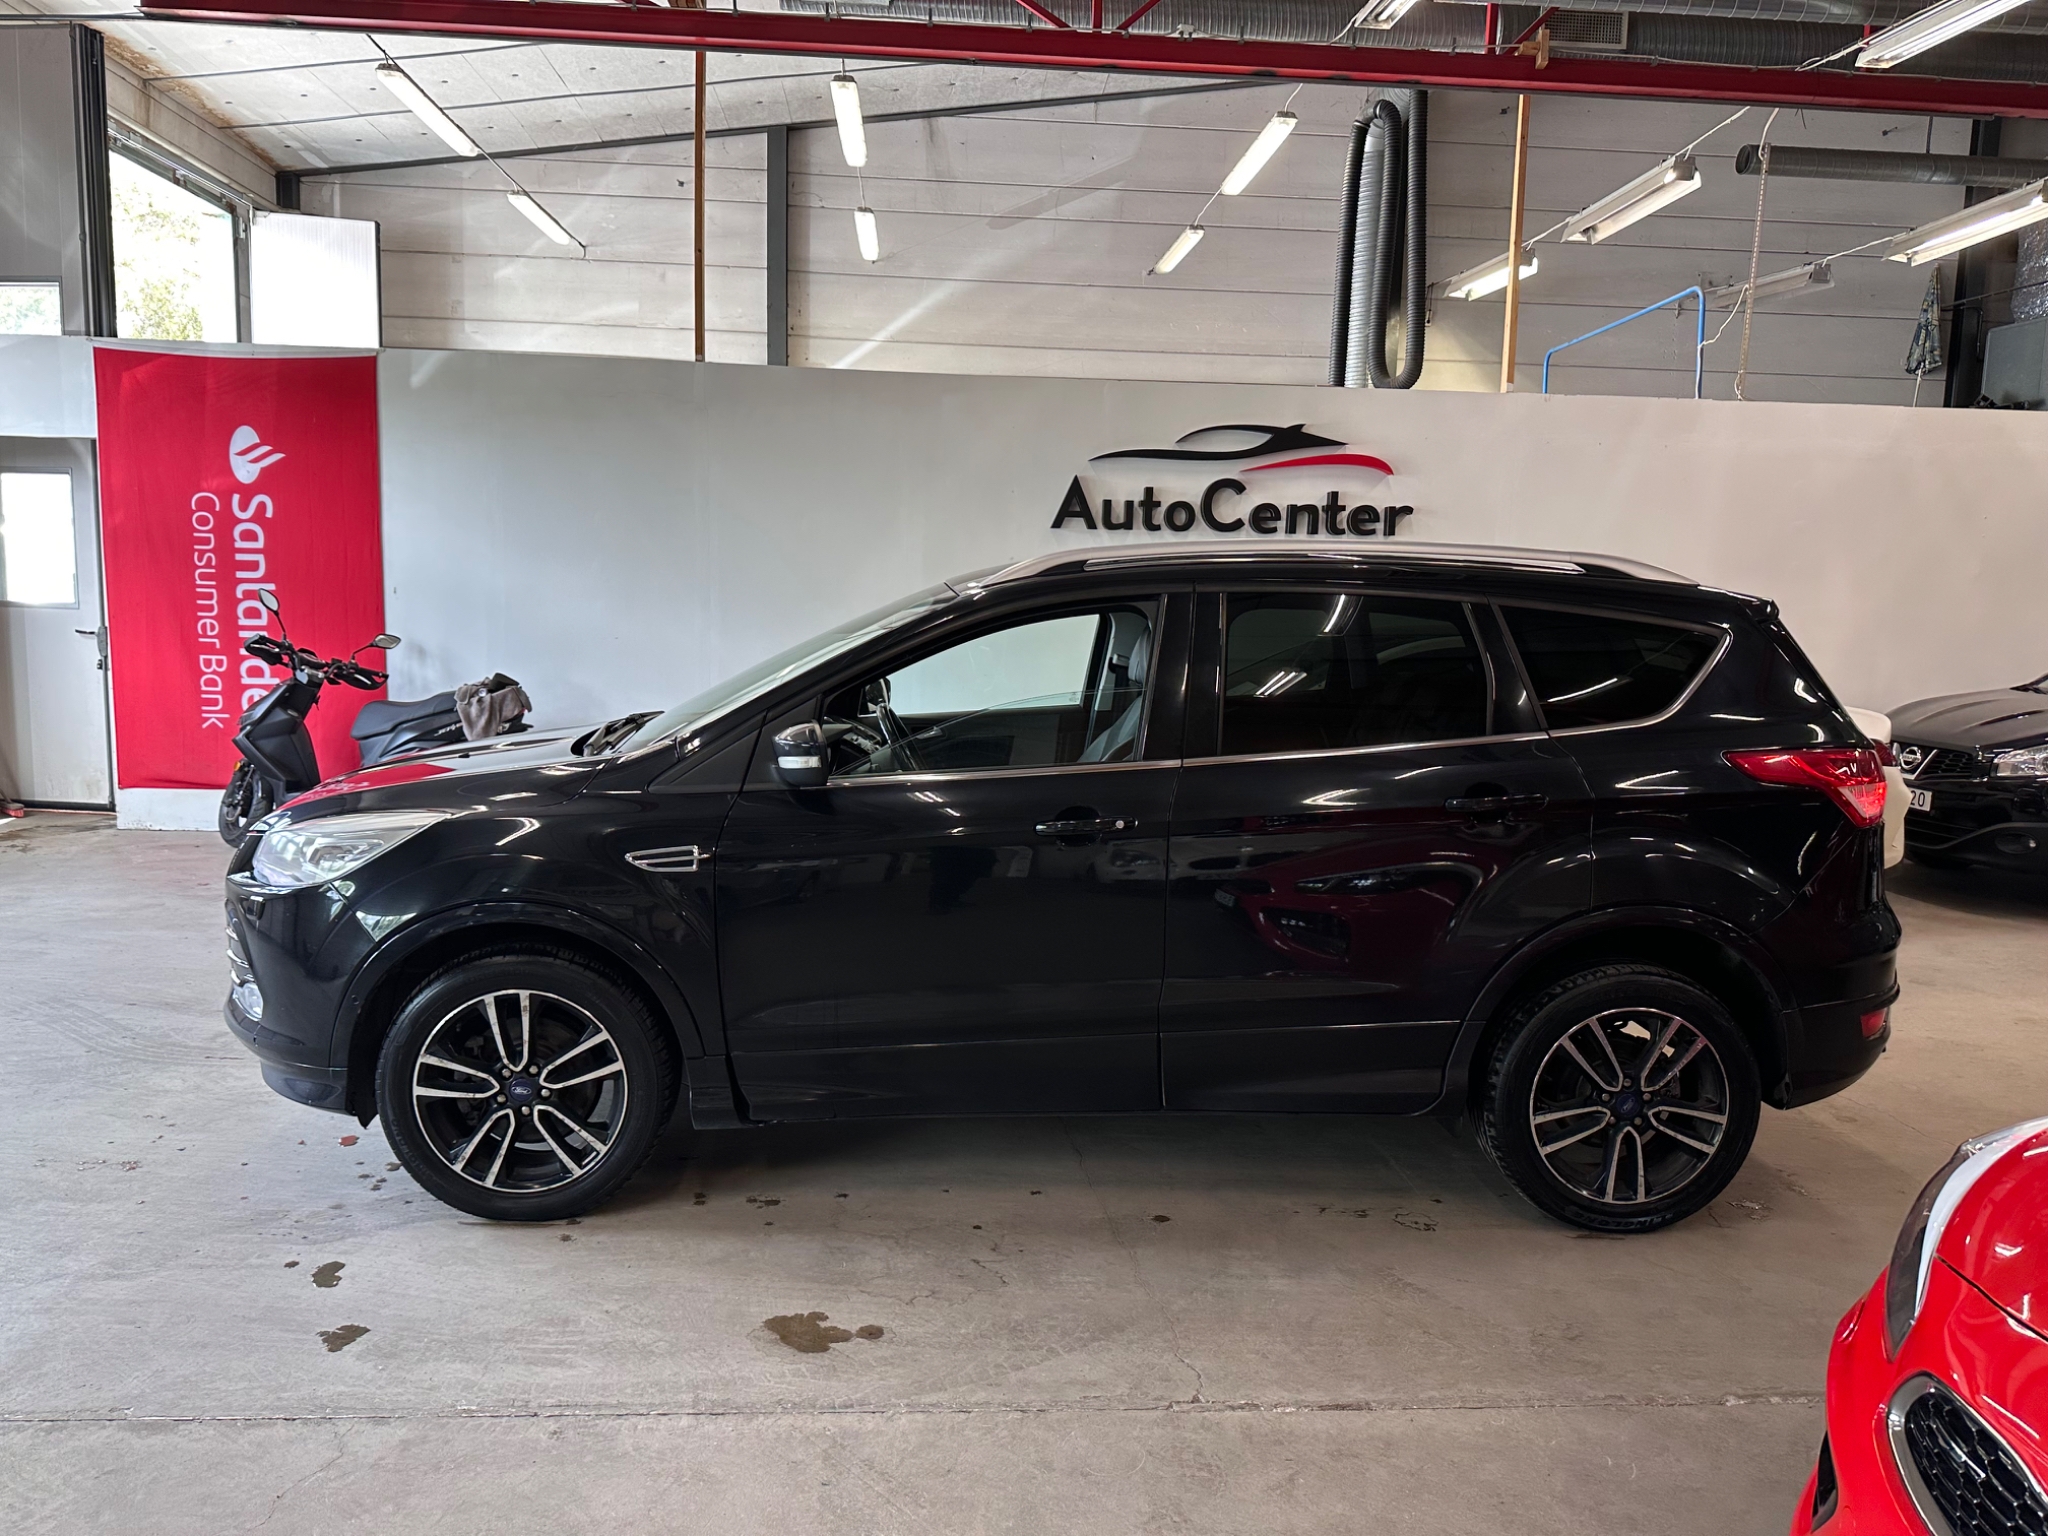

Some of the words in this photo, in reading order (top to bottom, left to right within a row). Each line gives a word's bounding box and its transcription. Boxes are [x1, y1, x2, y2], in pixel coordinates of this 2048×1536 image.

[1050, 474, 1414, 536] AutoCenter
[191, 492, 221, 649] Consumer
[199, 654, 230, 729] Bank
